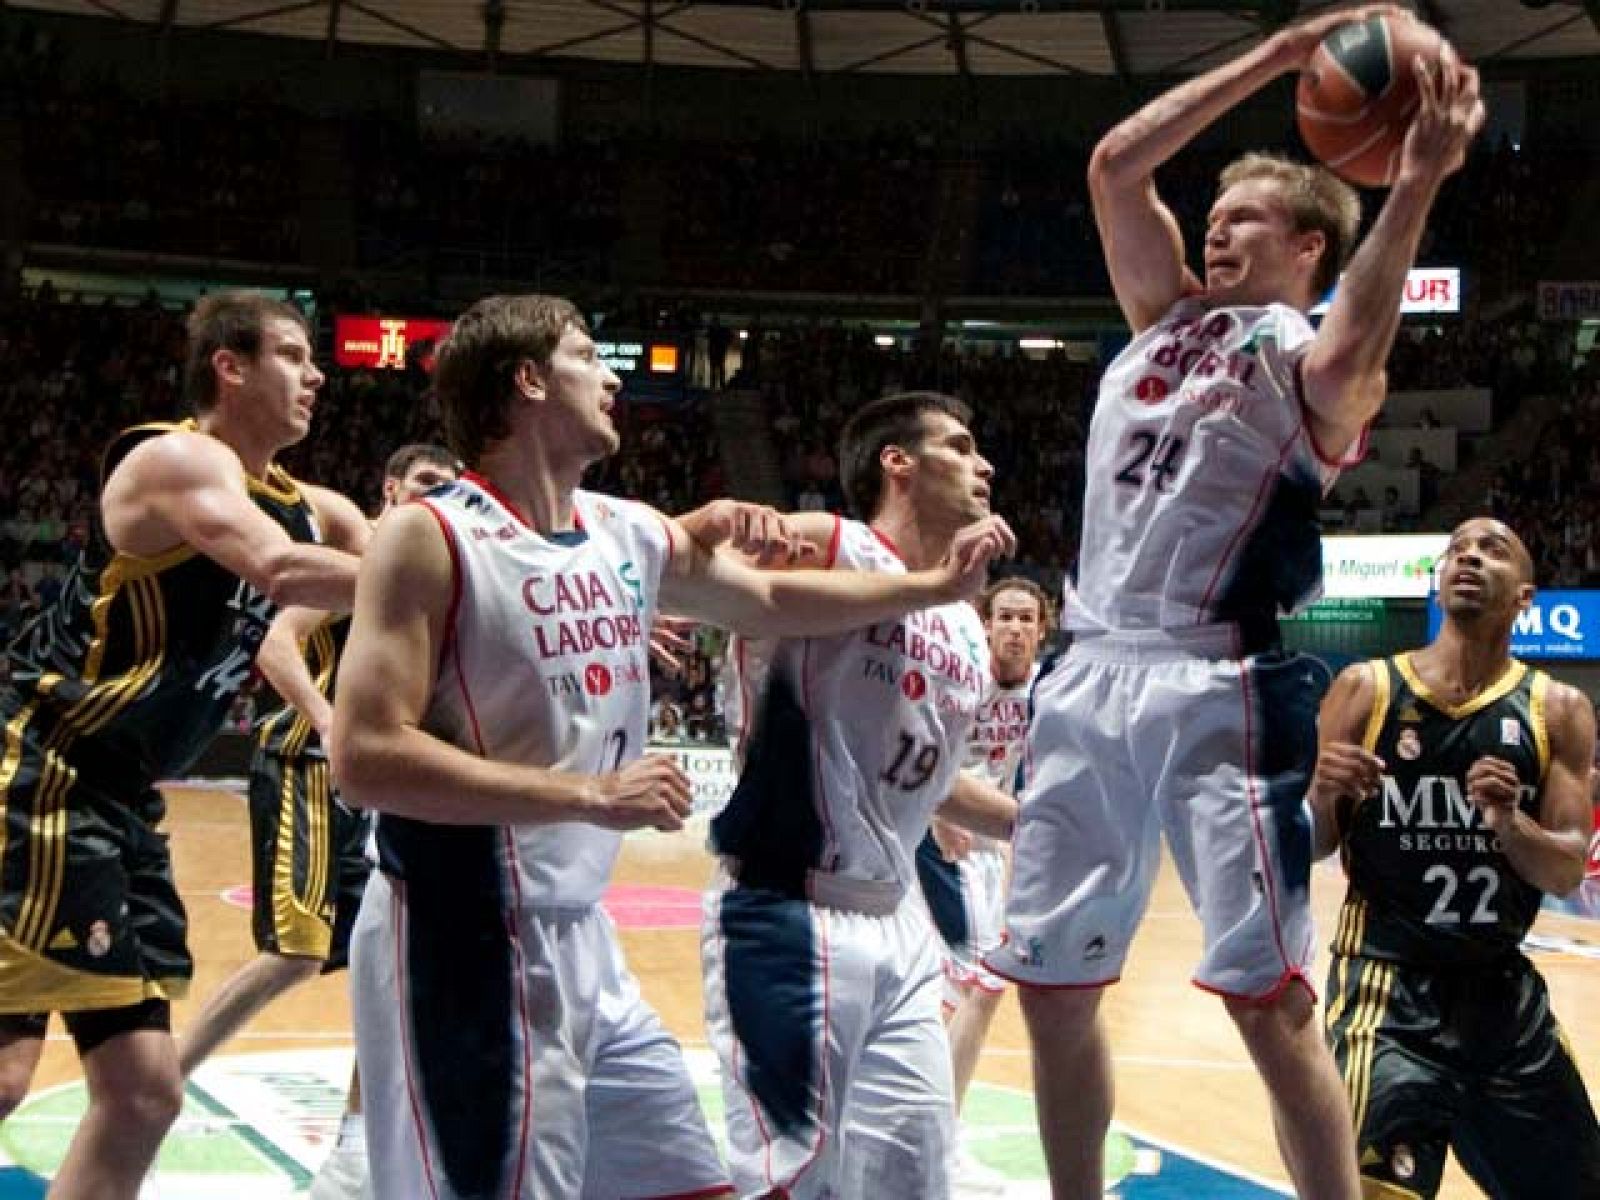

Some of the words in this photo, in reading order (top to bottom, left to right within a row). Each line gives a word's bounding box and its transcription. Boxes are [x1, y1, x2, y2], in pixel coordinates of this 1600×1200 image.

[1114, 430, 1183, 491] 24
[521, 570, 614, 616] CAJA
[880, 729, 939, 791] 19
[1422, 863, 1501, 925] 22
